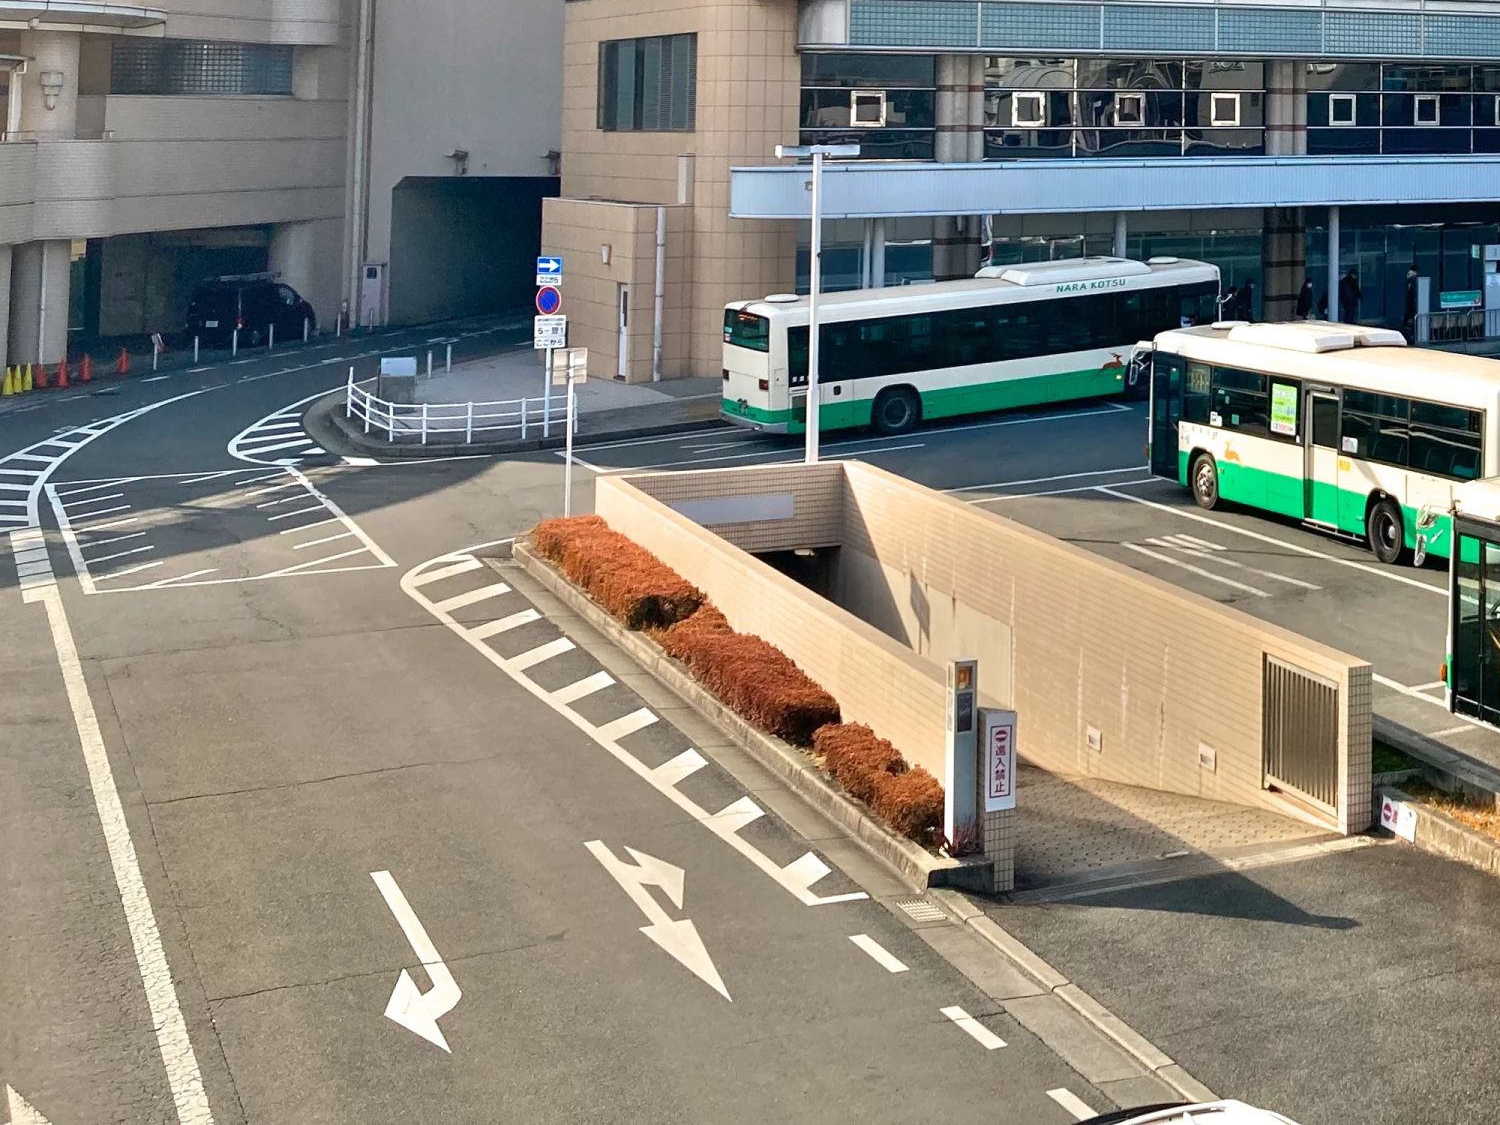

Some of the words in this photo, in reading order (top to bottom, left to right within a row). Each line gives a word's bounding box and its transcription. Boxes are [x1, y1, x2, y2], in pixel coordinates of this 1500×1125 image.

[1056, 283, 1087, 293] NARA
[1090, 278, 1126, 289] KOTSU
[535, 338, 563, 347] ここから
[995, 745, 1006, 794] 進入禁止
